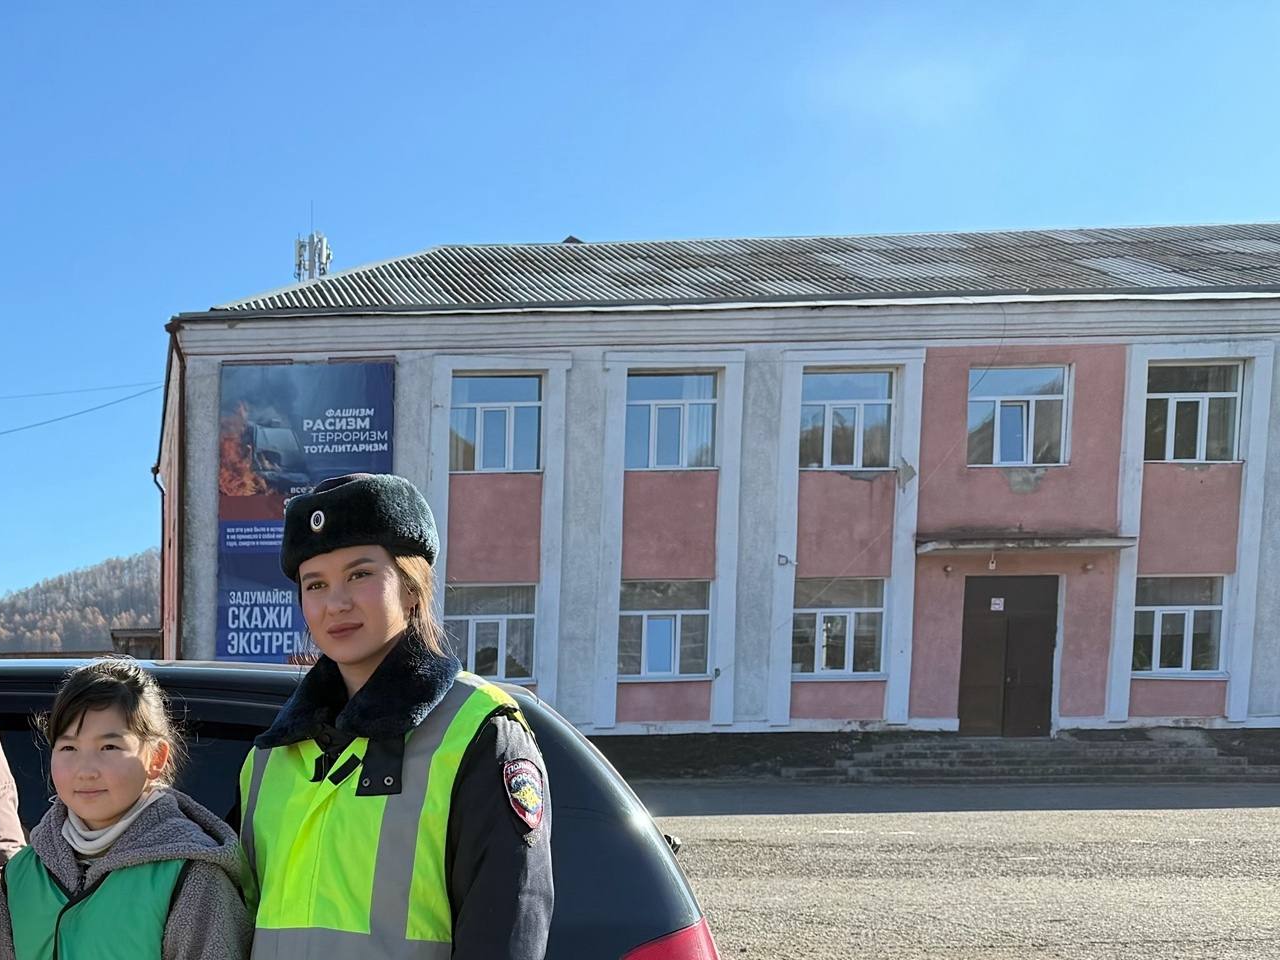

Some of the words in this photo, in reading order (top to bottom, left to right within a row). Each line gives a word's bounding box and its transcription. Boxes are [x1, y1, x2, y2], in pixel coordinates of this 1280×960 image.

[325, 408, 375, 417] ФАШИЗМ
[303, 417, 370, 431] РАСИЗМ
[311, 430, 388, 442] ТЕРРОРИЗМ
[303, 443, 388, 453] ТОТАЛИТАРИЗМ
[229, 588, 293, 606] ЗАДУМАЙСЯ
[228, 606, 293, 629] СКАЖИ
[227, 632, 308, 655] ЭКСТРЕМ
